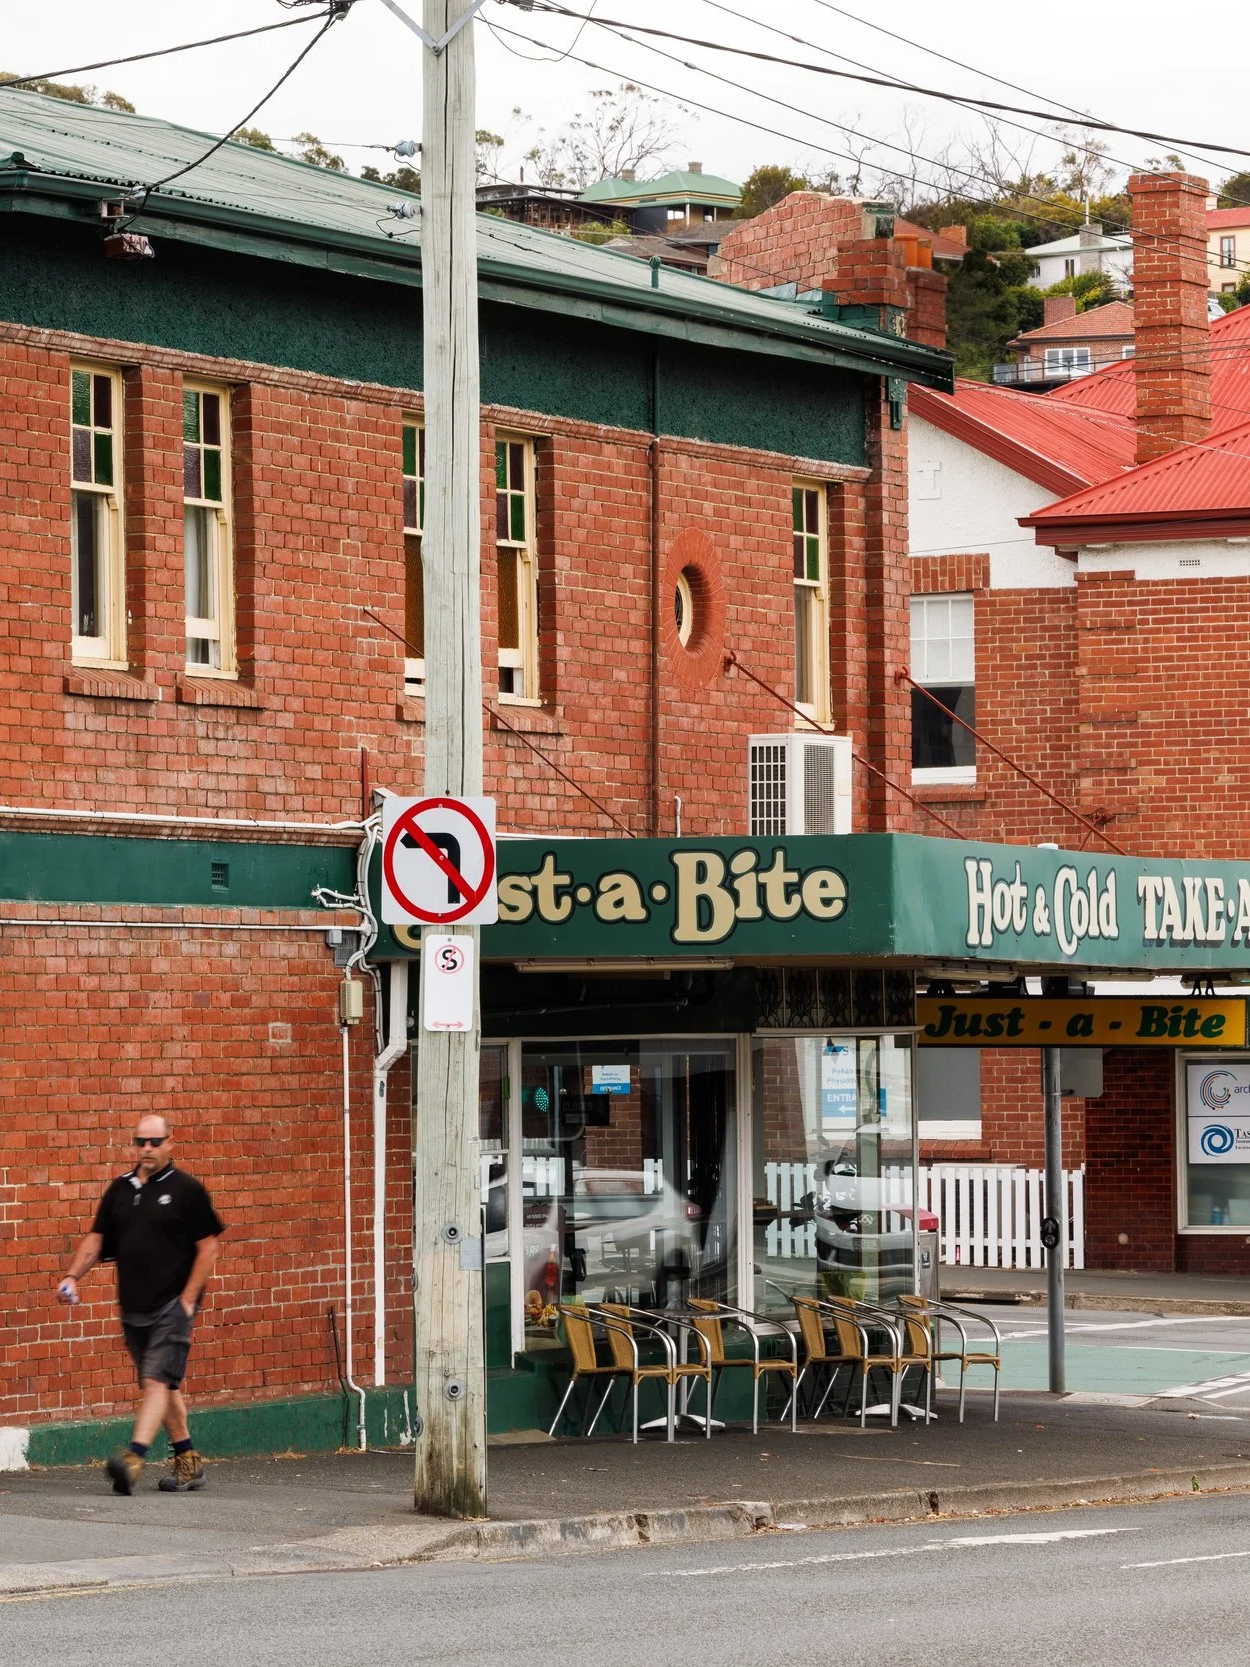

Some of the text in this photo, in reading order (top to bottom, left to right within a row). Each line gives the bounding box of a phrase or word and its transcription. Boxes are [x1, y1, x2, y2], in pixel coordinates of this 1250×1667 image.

[392, 850, 847, 949] st·a·Bite
[965, 857, 1029, 947] Hot
[1033, 884, 1051, 936] &
[1054, 865, 1119, 956] Cold
[441, 949, 458, 971] S
[925, 1004, 1025, 1038] Just
[1066, 1012, 1095, 1038] a
[1136, 1005, 1227, 1039] Bite
[827, 1093, 856, 1103] ENTRA
